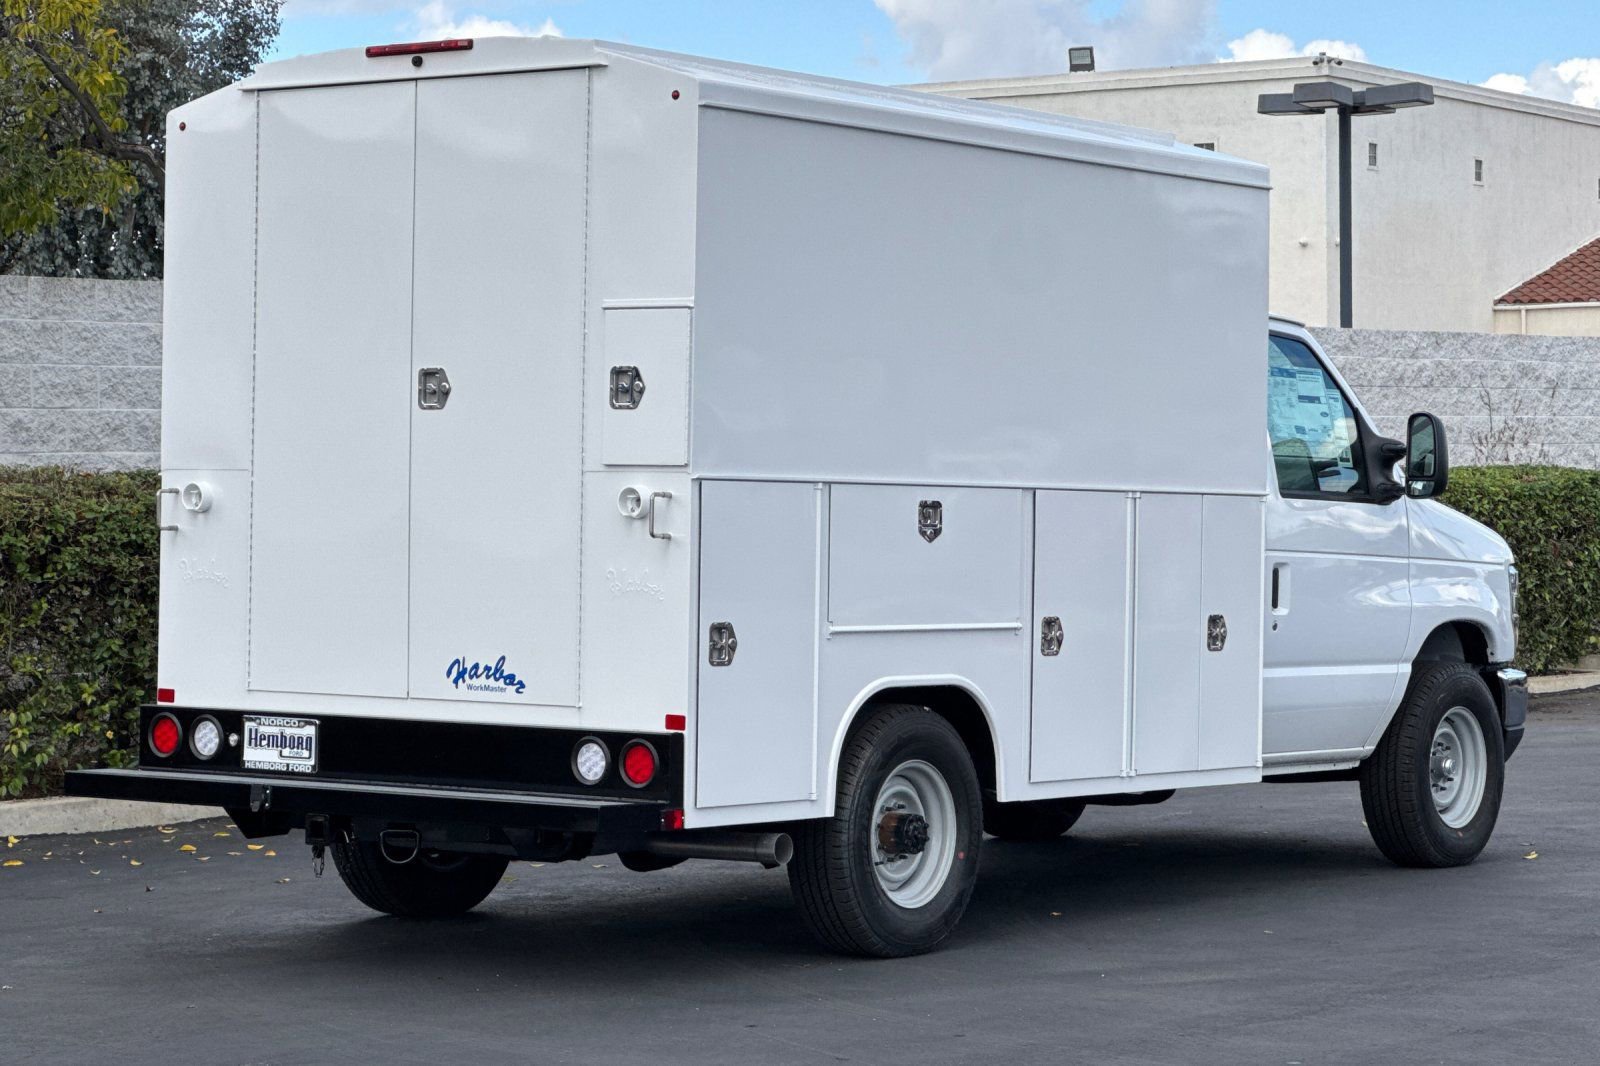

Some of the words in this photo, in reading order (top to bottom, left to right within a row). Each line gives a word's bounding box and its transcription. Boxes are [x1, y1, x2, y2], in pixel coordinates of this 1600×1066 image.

[446, 655, 526, 694] Harbor
[466, 683, 507, 693] WorkMaster
[260, 717, 299, 728] NORCO
[245, 761, 287, 771] HEMBORG
[289, 763, 312, 773] FORD
